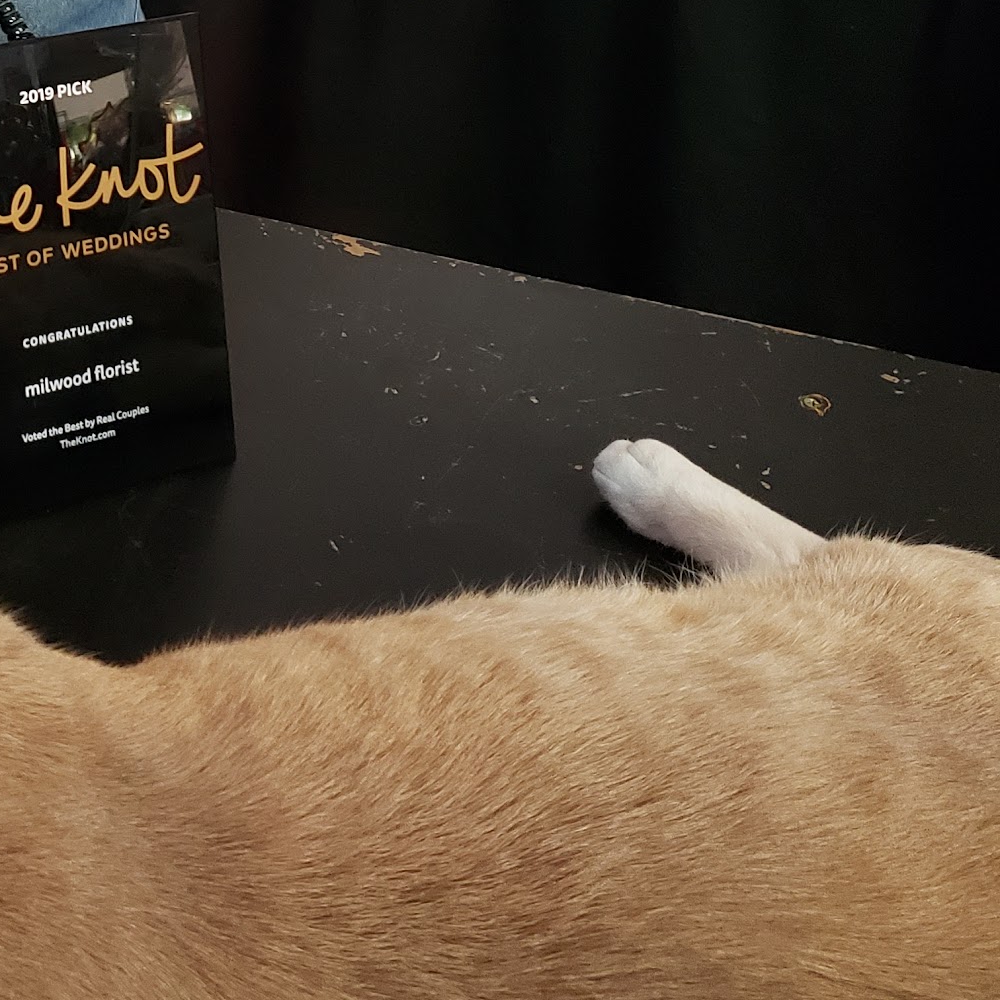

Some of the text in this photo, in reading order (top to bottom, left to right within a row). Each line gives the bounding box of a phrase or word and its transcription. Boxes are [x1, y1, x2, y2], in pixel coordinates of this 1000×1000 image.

[19, 80, 93, 105] 2019 PICK
[26, 246, 54, 267] OF
[60, 223, 171, 260] WEDDINGS
[22, 314, 134, 349] CONGRATULATIONS
[24, 358, 140, 398] milwood florist
[21, 405, 150, 443] Voted the Best by Real Couples
[59, 429, 117, 449] TheKnot.com
